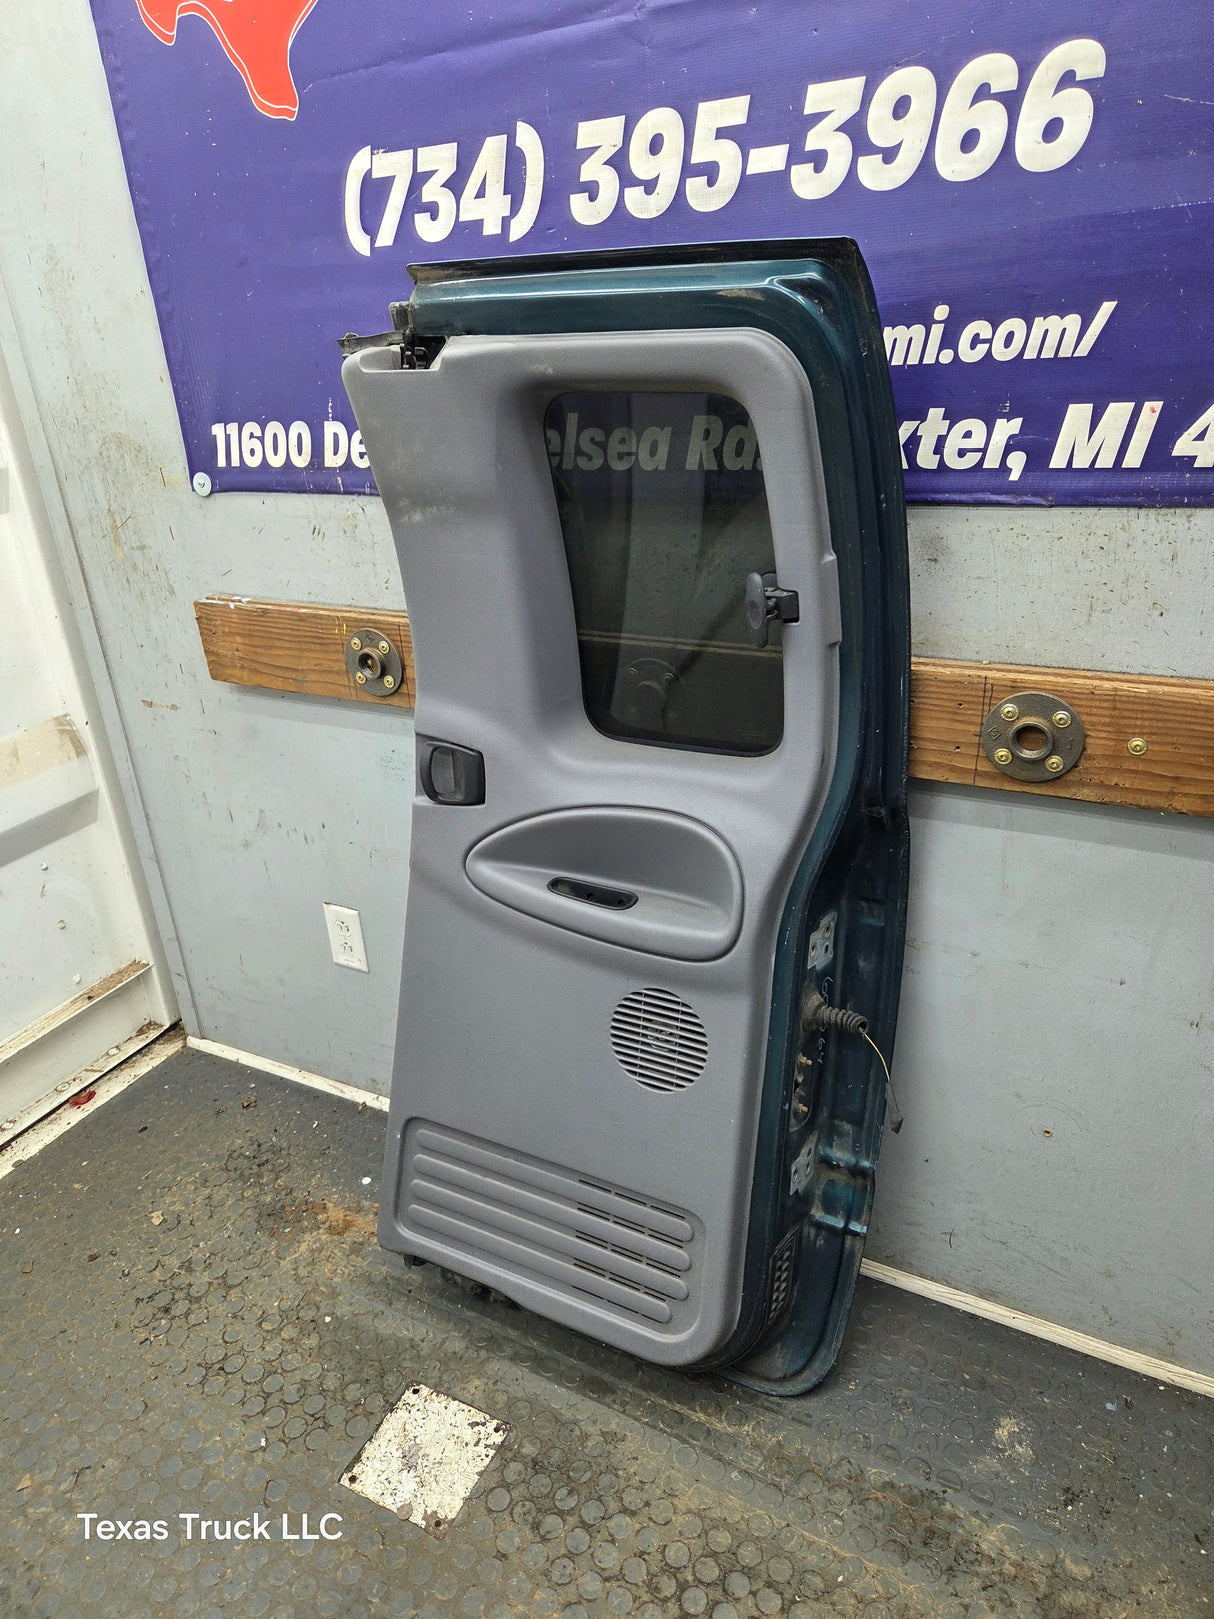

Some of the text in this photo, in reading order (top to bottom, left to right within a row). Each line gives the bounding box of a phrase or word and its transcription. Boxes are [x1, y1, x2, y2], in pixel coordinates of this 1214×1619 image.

[344, 39, 1106, 257] (734) 395-3966
[883, 301, 1118, 366] mi.com/
[211, 420, 312, 468] 11600
[1048, 401, 1164, 468] MI
